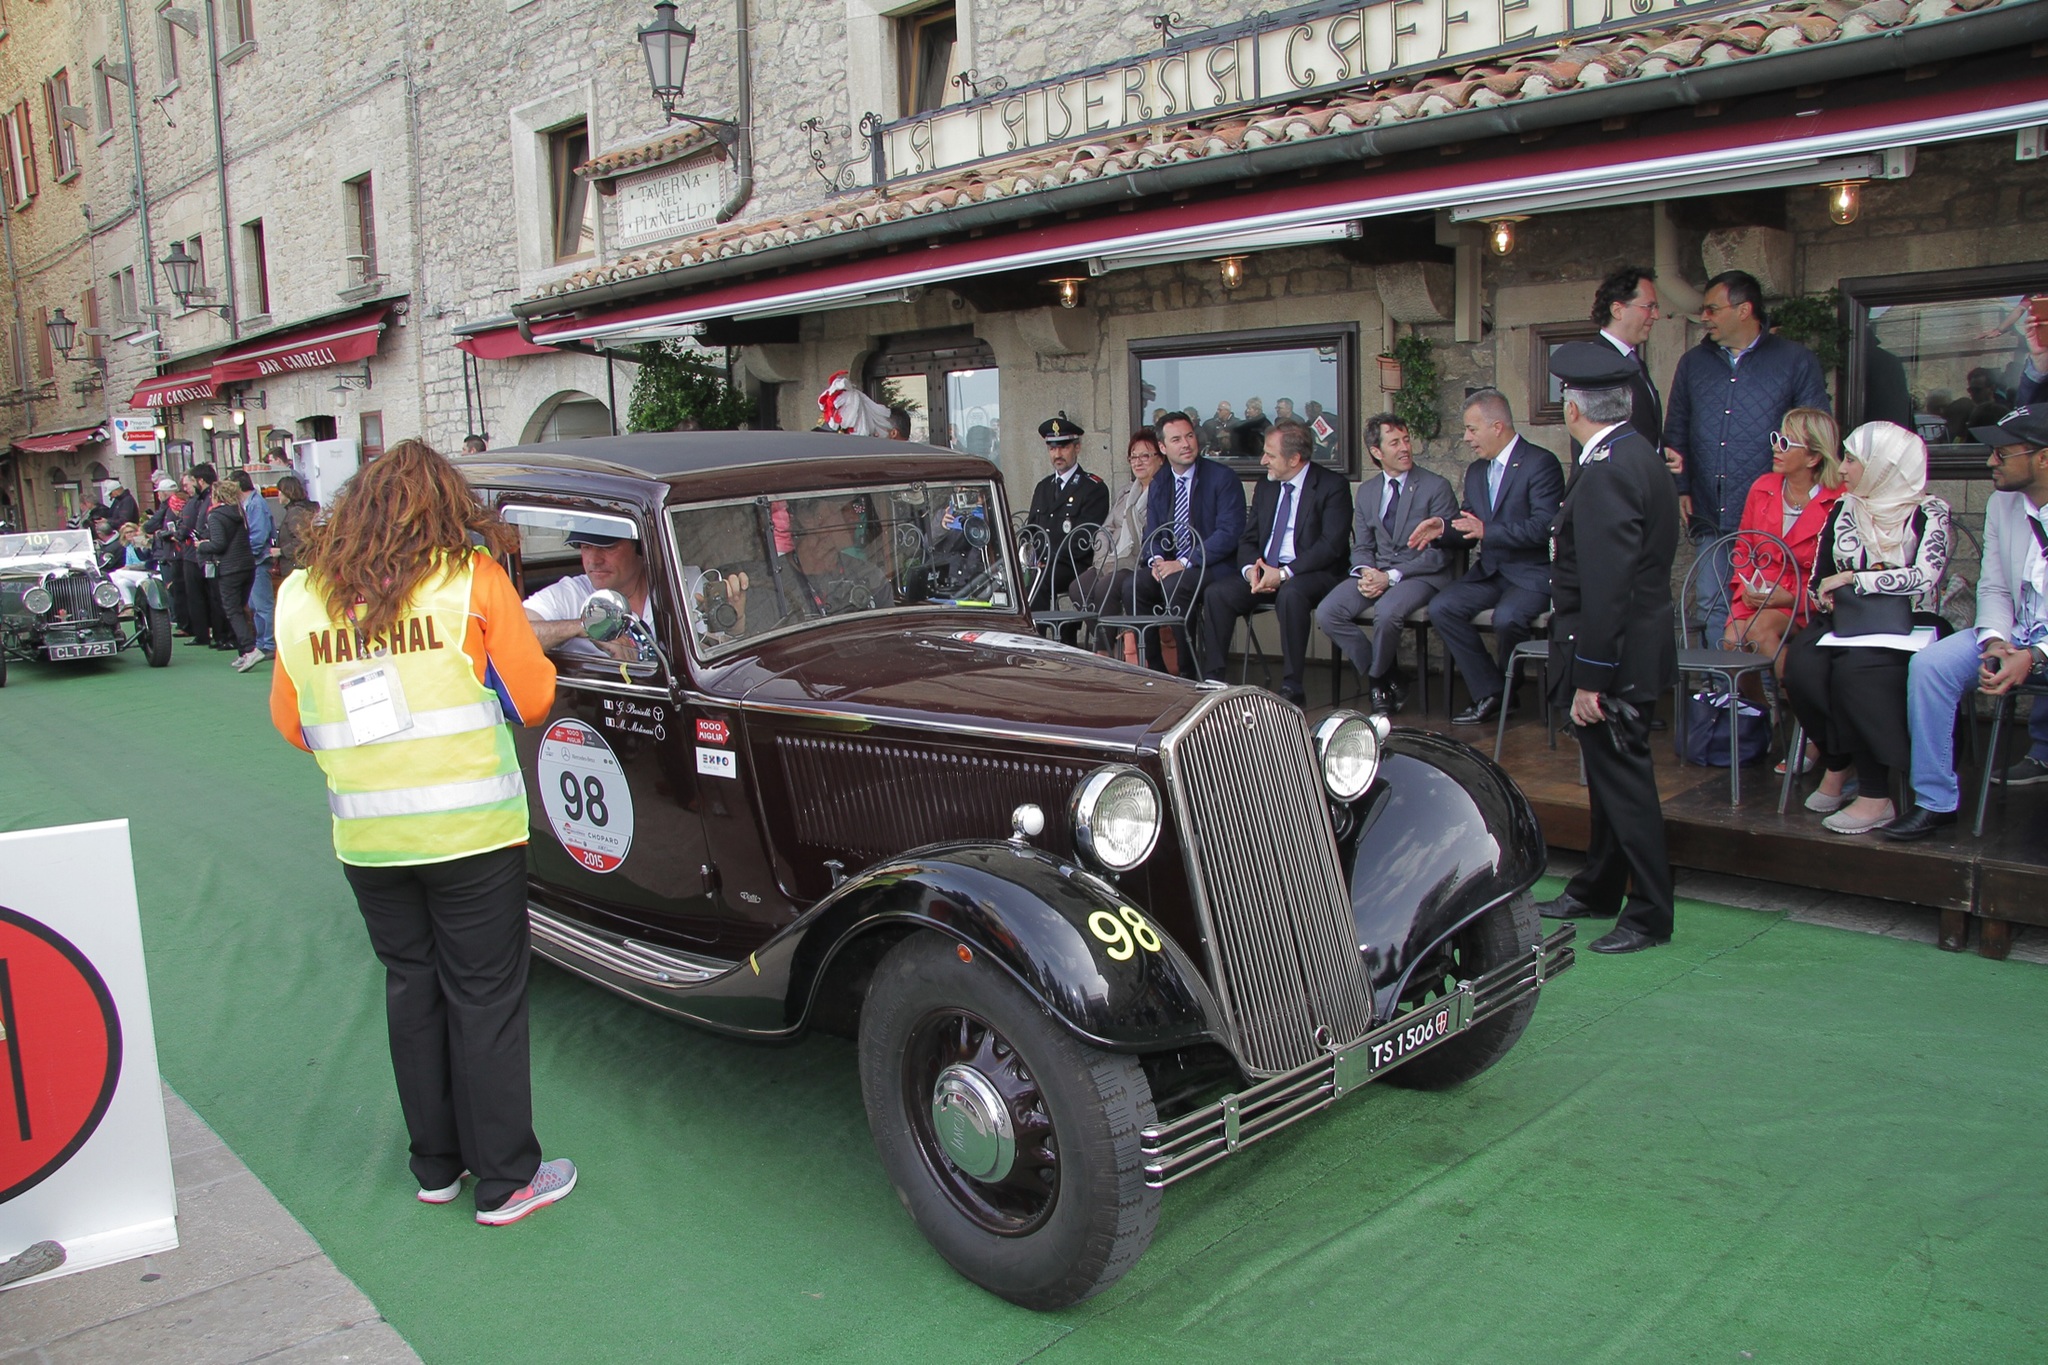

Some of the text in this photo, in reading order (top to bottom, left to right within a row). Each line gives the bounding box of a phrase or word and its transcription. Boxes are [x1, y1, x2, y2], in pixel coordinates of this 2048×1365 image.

[887, 118, 935, 180] LA
[966, 39, 1242, 158] TAVERNA
[638, 172, 702, 201] TAVERNA
[660, 195, 678, 208] DEL
[635, 202, 707, 233] PIANELLO
[257, 348, 337, 375] BAR CARDELLI
[146, 384, 213, 407] BAR CARDELLI
[25, 534, 51, 546] 101
[309, 615, 444, 665] MARSHAL
[56, 643, 110, 658] CLT 725
[566, 729, 580, 737] 1000
[699, 721, 721, 731] 1000
[566, 736, 582, 744] MIGLIA
[699, 731, 724, 742] MIGLIA
[702, 753, 729, 766] EXPO
[559, 770, 610, 828] 98
[587, 832, 619, 845] CHOPARD
[583, 850, 604, 868] 2015
[1088, 906, 1162, 961] 98
[1372, 1018, 1434, 1068] TS 1506
